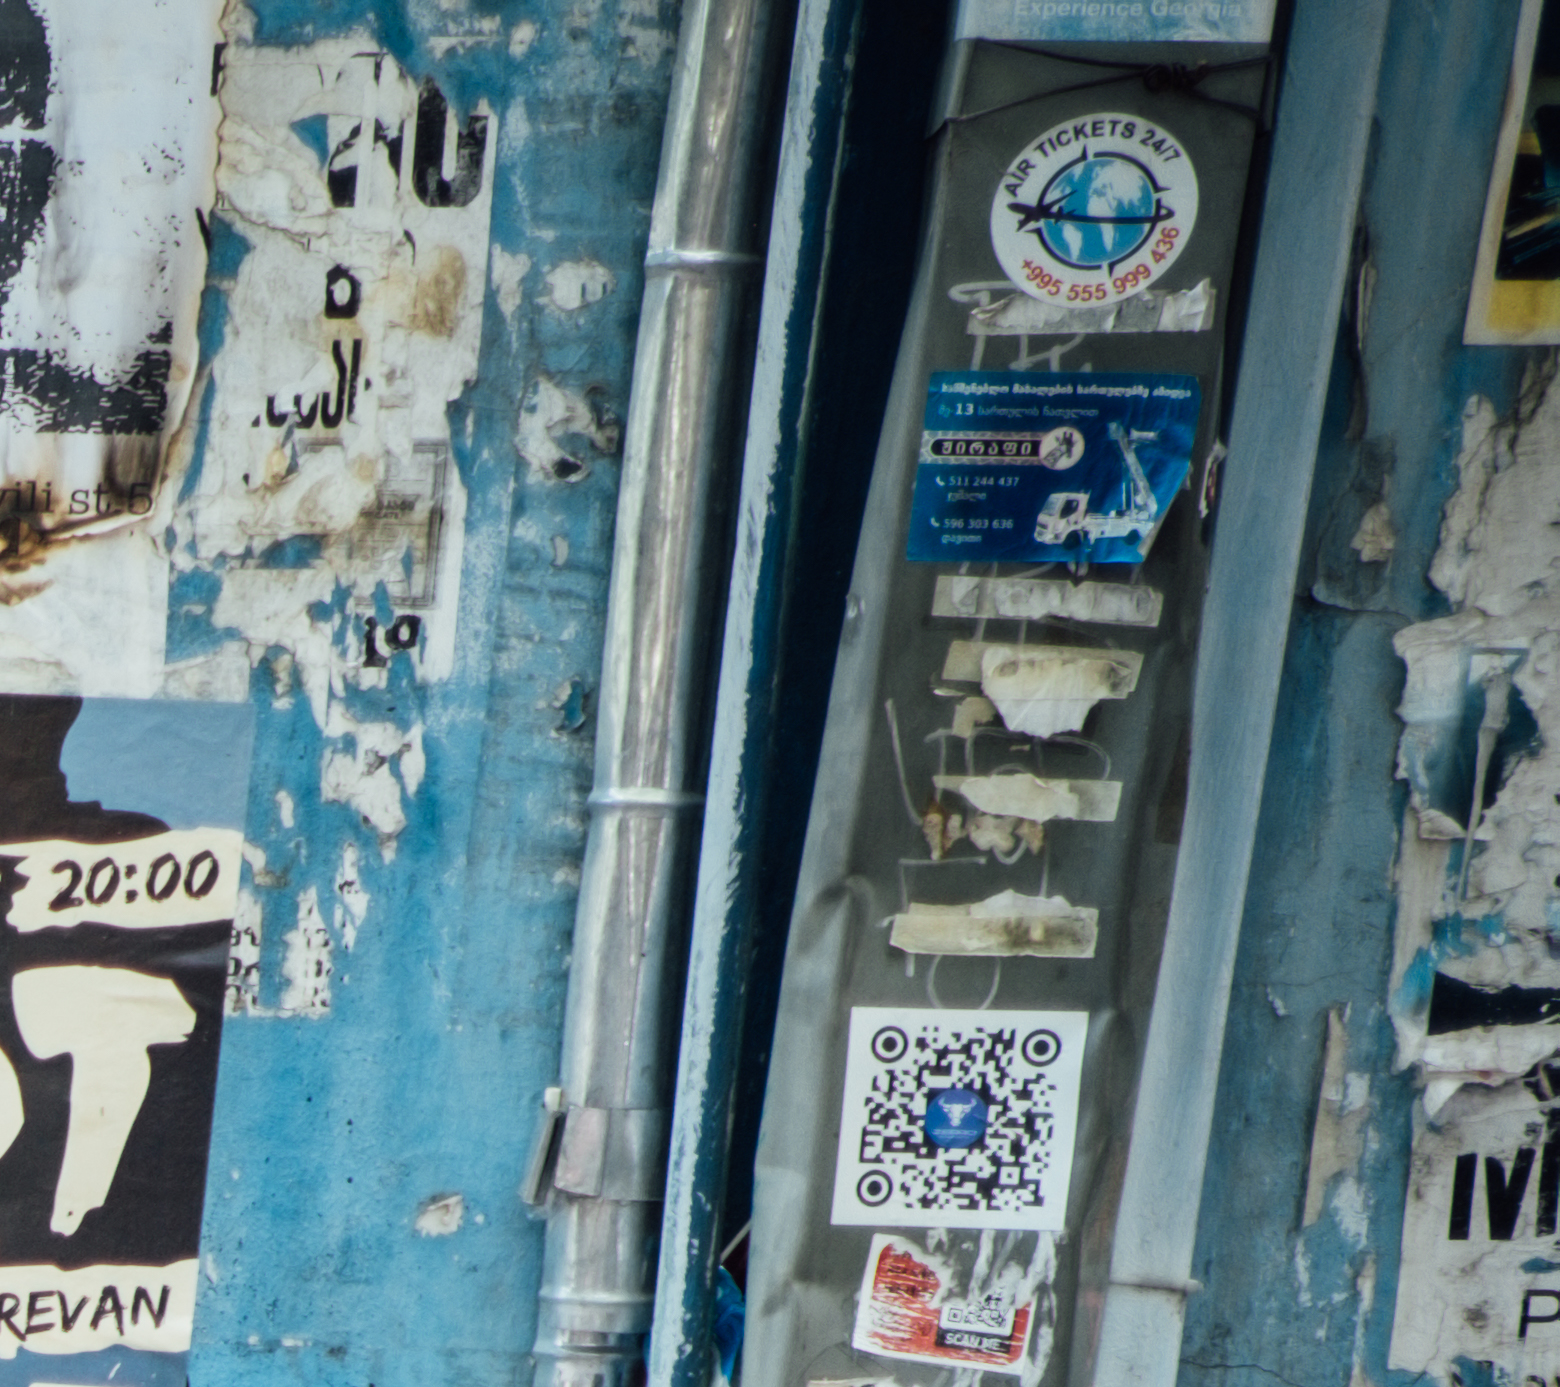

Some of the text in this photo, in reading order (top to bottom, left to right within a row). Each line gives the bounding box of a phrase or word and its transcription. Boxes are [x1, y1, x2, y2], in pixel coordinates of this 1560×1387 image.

[1014, 1, 1242, 20] Experience Georgia
[1003, 119, 1183, 198] AIR TICKETS 24/7
[1021, 226, 1180, 302] +995 555 999 436
[942, 441, 1031, 455] ჟირაფი
[948, 475, 1020, 487] 511 244 437
[49, 849, 220, 911] 20:00
[944, 1333, 979, 1347] SCAN
